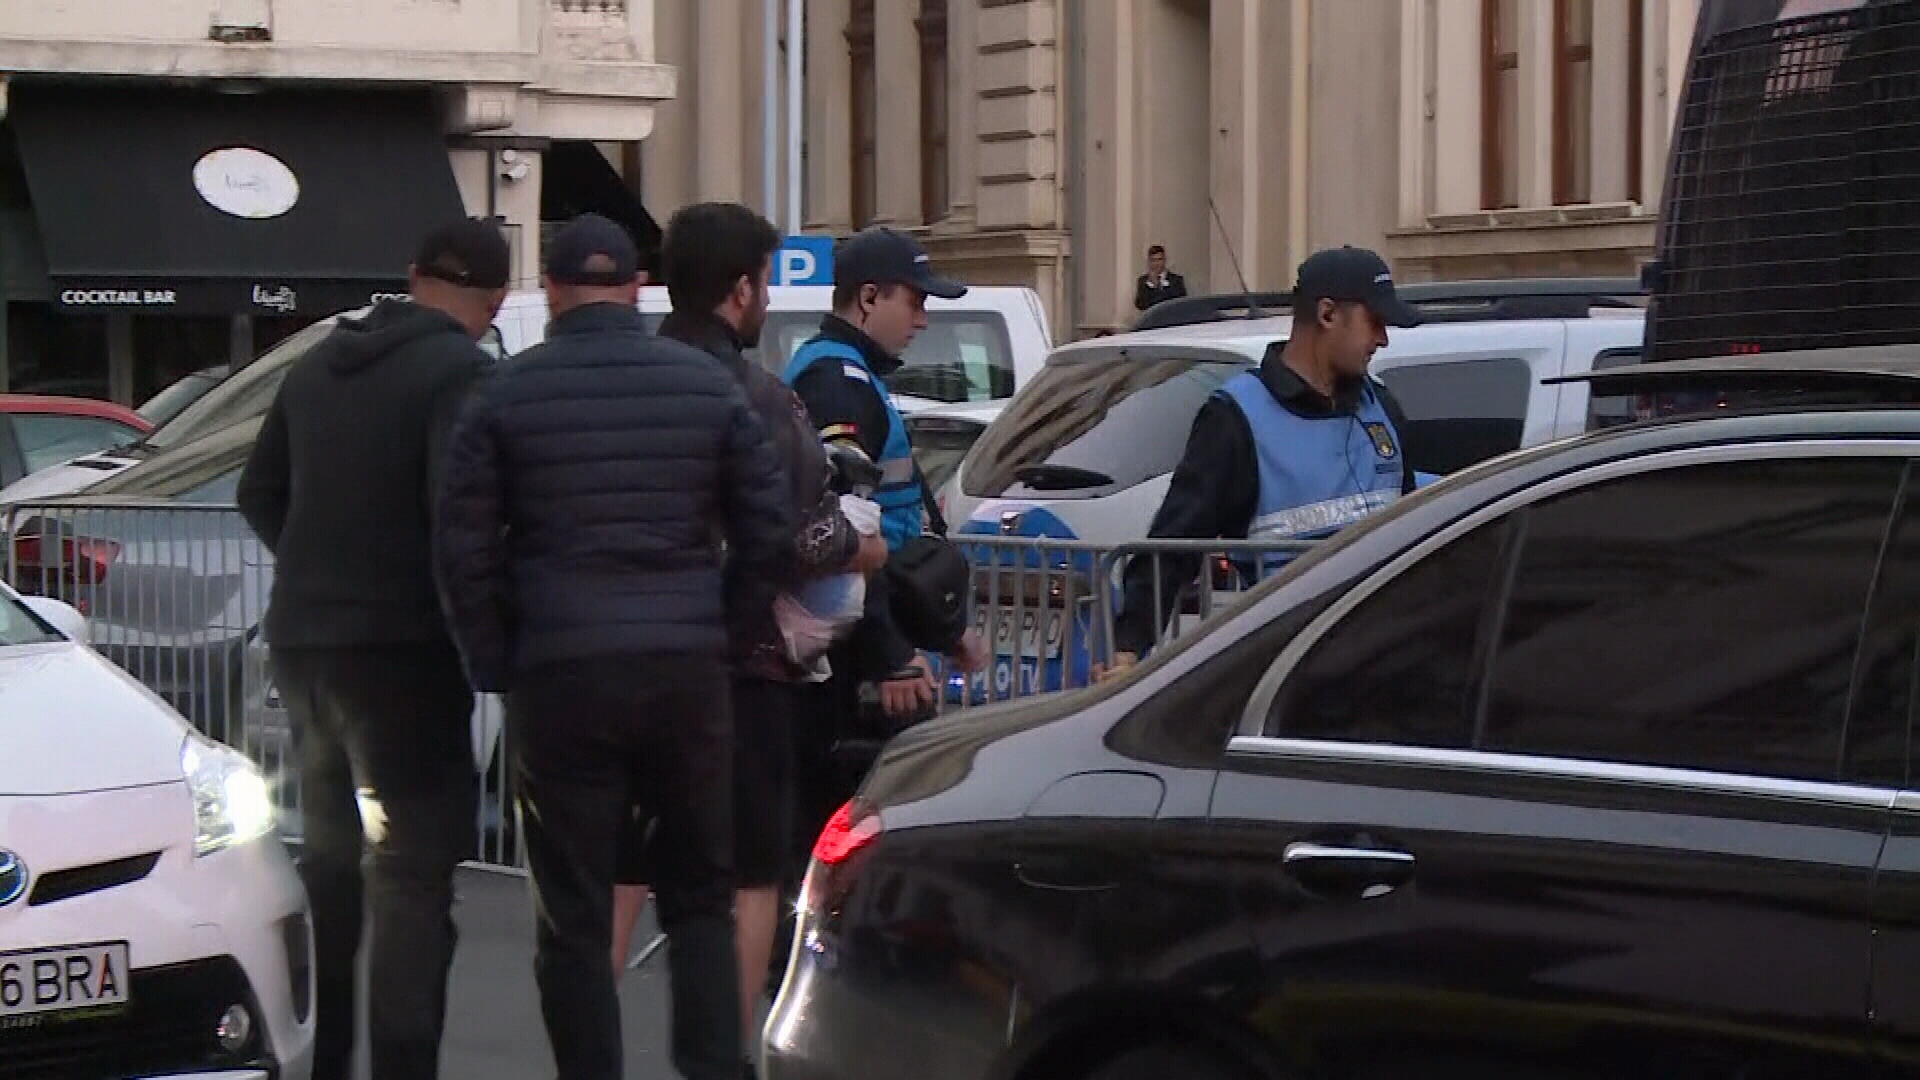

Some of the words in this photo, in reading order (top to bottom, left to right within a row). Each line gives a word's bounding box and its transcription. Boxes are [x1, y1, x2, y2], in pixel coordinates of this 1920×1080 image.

[780, 249, 816, 285] P
[61, 289, 141, 304] COCKTAIL
[143, 289, 177, 304] BAR
[34, 953, 118, 1004] BRA
